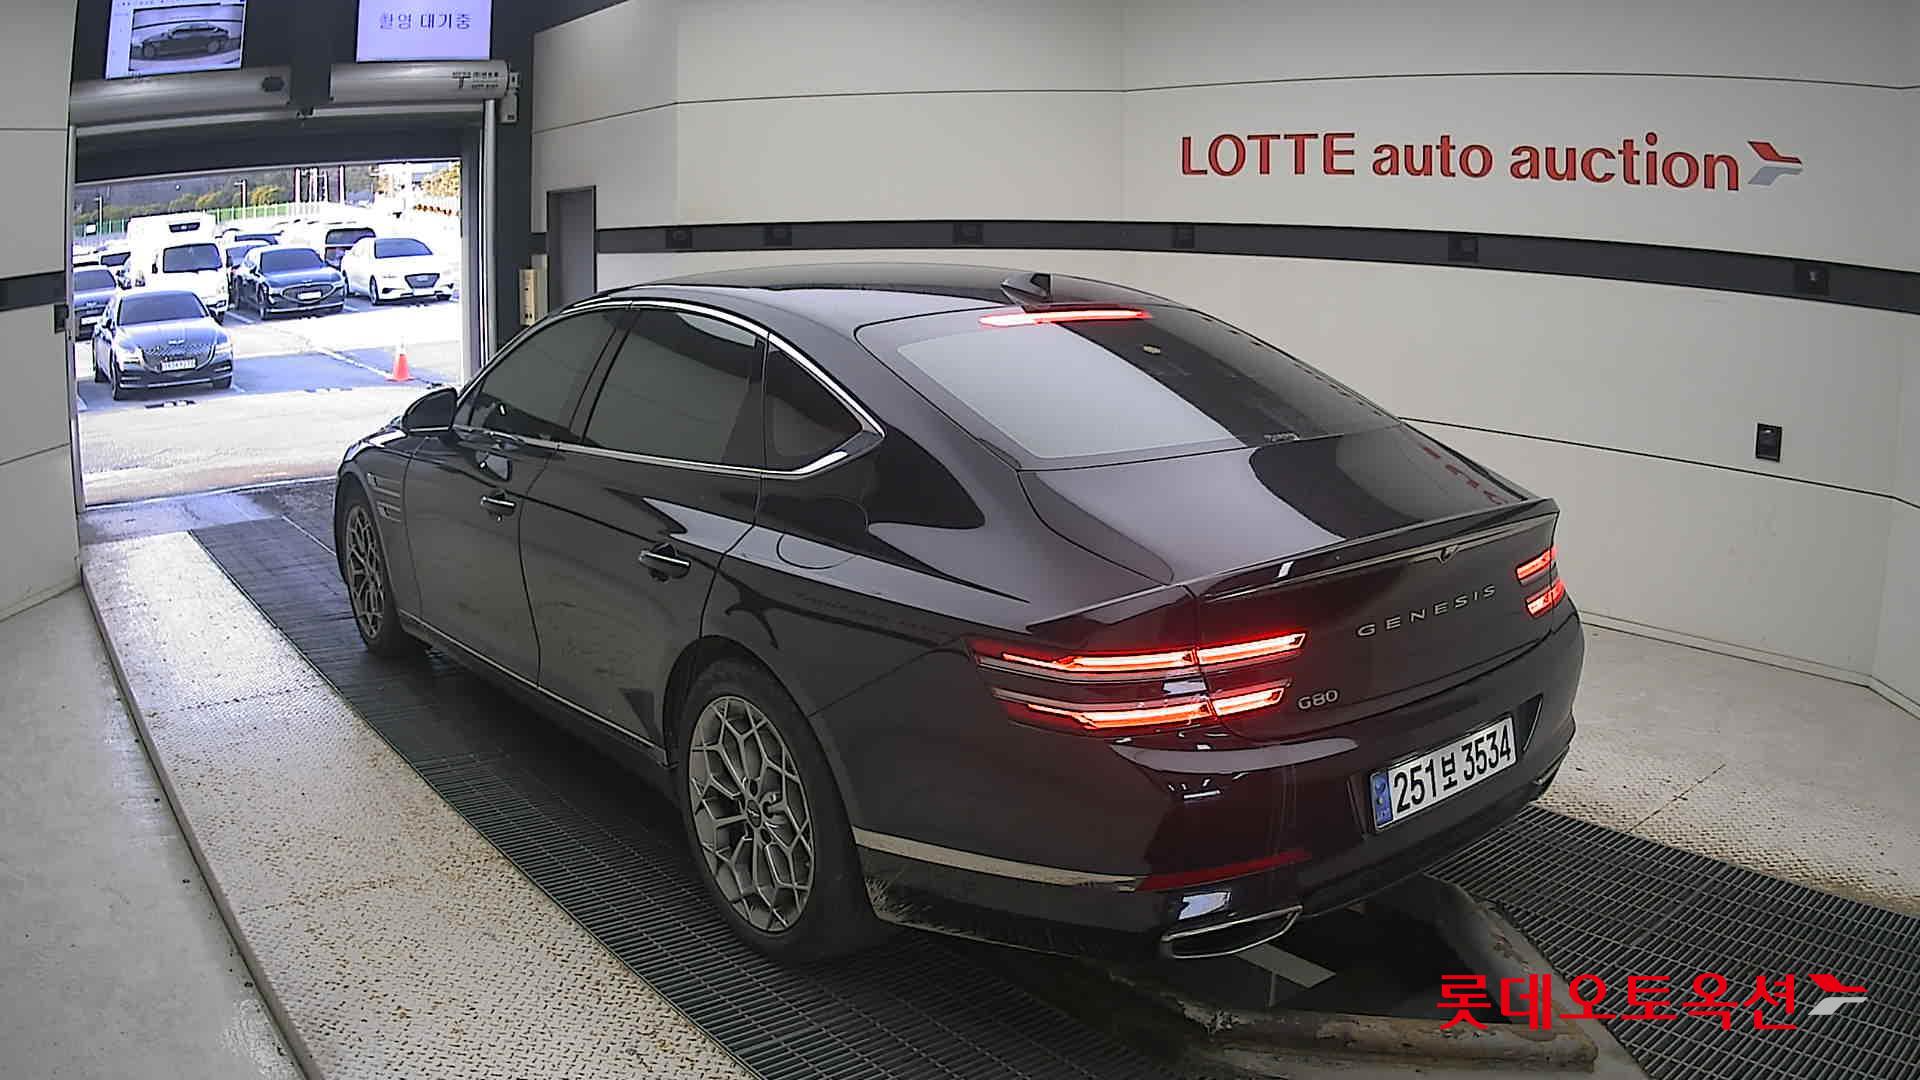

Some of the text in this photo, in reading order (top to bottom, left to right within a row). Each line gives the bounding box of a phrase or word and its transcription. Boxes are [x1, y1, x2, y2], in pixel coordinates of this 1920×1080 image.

[420, 13, 472, 30] 대기중
[1181, 131, 1740, 191] LOTTE auto auction
[1357, 584, 1496, 637] GENESIS
[1298, 689, 1339, 710] G80
[1393, 724, 1512, 813] 251보 3534
